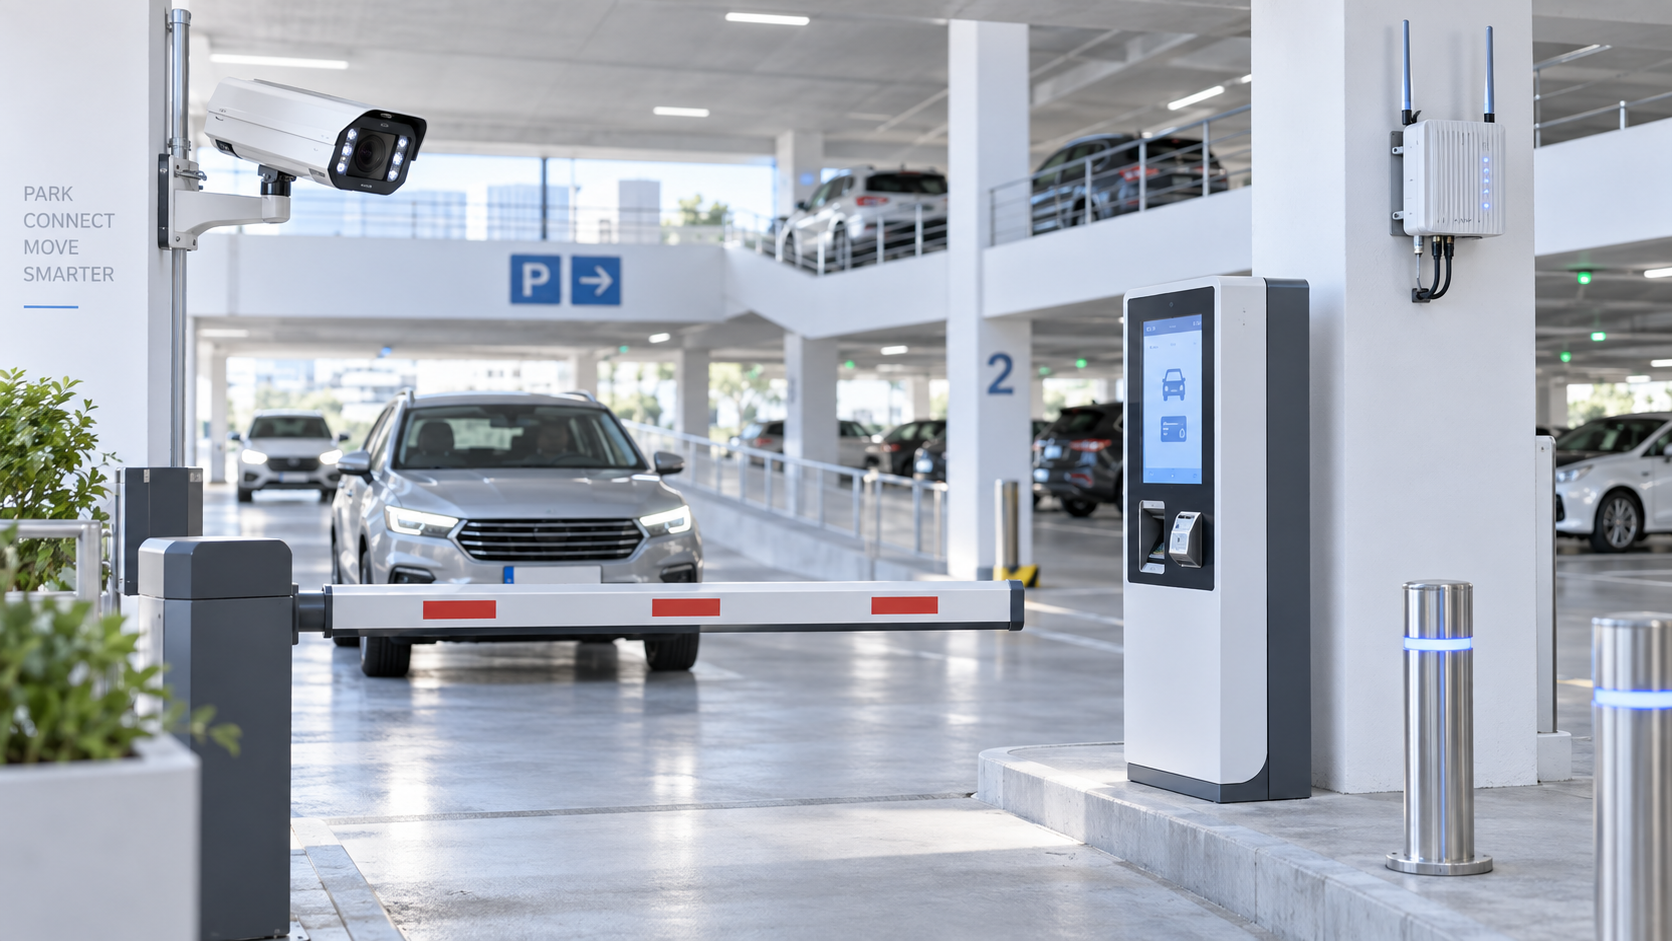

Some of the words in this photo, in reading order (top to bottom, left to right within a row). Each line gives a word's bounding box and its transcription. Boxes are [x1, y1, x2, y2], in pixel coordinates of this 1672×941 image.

[23, 185, 74, 202] PARK
[23, 212, 116, 229] CONNECT
[23, 239, 79, 256] MOVE
[23, 266, 115, 283] SMARTER
[523, 263, 550, 296] P
[987, 352, 1014, 395] 2
